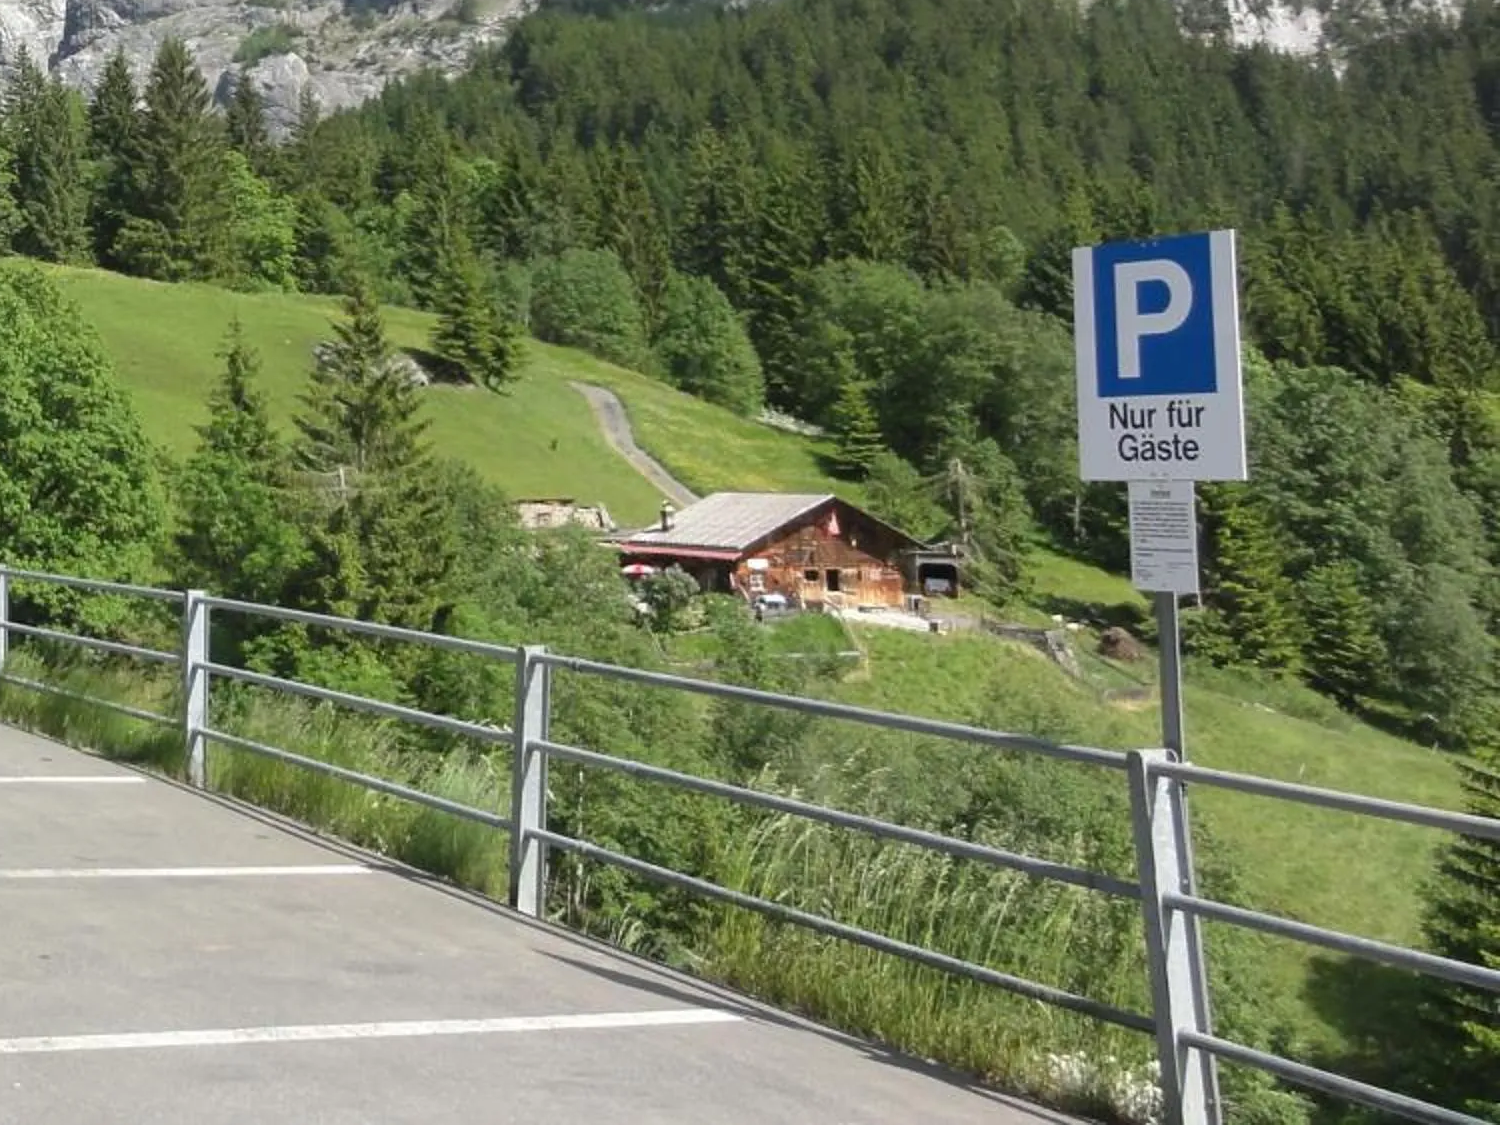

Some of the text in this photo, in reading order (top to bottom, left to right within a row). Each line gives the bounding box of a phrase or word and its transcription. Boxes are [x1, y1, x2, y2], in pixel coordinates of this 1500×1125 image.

[1113, 258, 1193, 380] P
[1109, 400, 1205, 430] Nur für
[1117, 433, 1199, 462] Gäste
